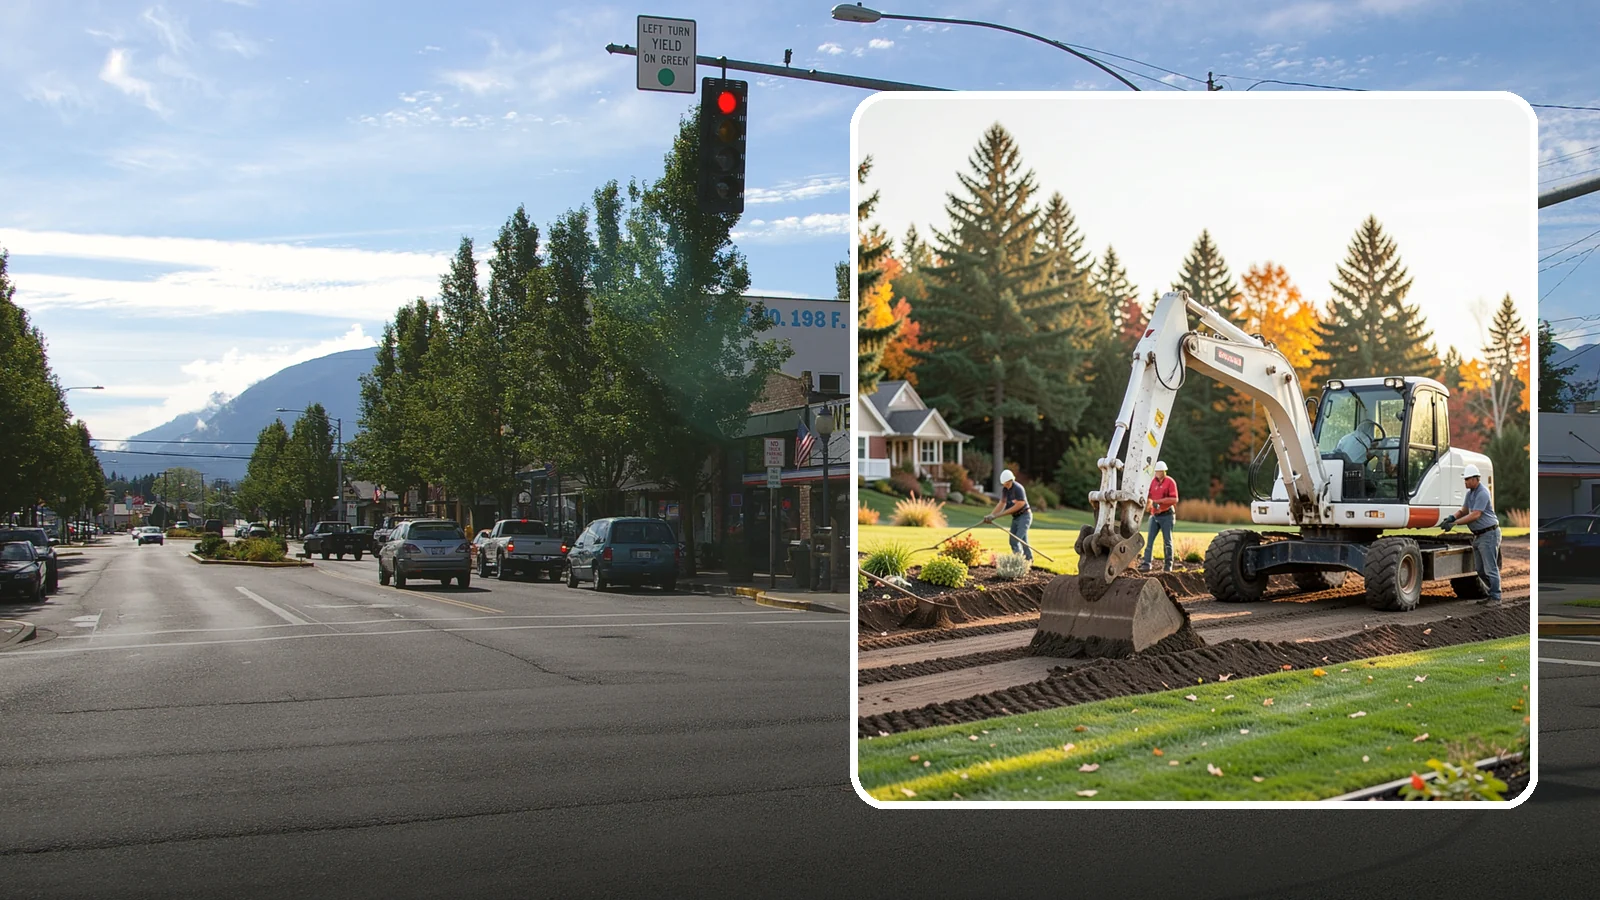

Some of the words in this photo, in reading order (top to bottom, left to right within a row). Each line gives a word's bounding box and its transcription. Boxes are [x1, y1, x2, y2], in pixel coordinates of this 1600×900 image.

[643, 24, 663, 34] LEFT
[668, 25, 690, 37] TURN
[652, 38, 682, 52] YIELD
[644, 53, 656, 63] ON
[661, 55, 688, 66] GREEN
[791, 310, 826, 328] 198
[832, 312, 846, 329] F.
